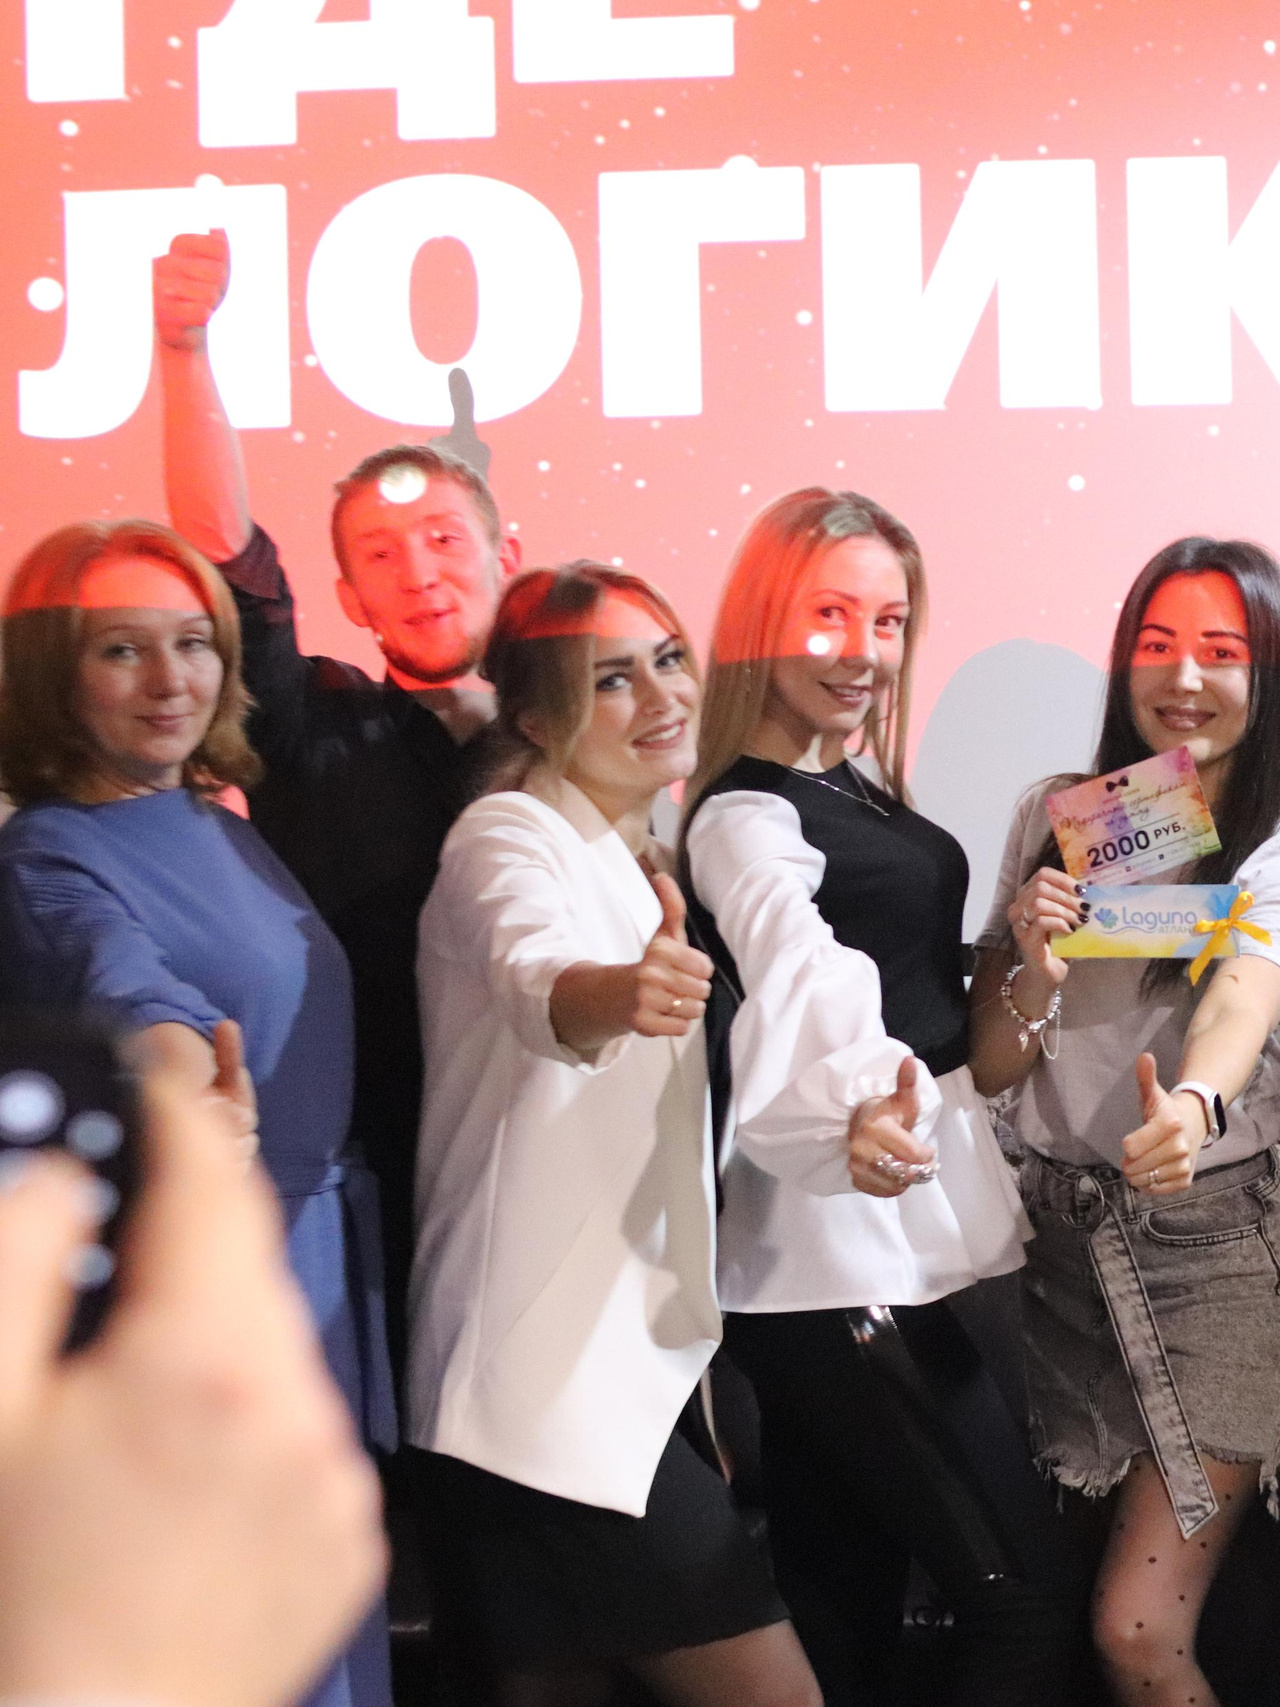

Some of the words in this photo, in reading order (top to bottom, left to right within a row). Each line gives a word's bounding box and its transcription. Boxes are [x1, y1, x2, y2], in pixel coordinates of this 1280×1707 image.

[1086, 830, 1150, 868] 2000
[1154, 822, 1186, 840] РУБ.
[1122, 906, 1198, 930] Laguna
